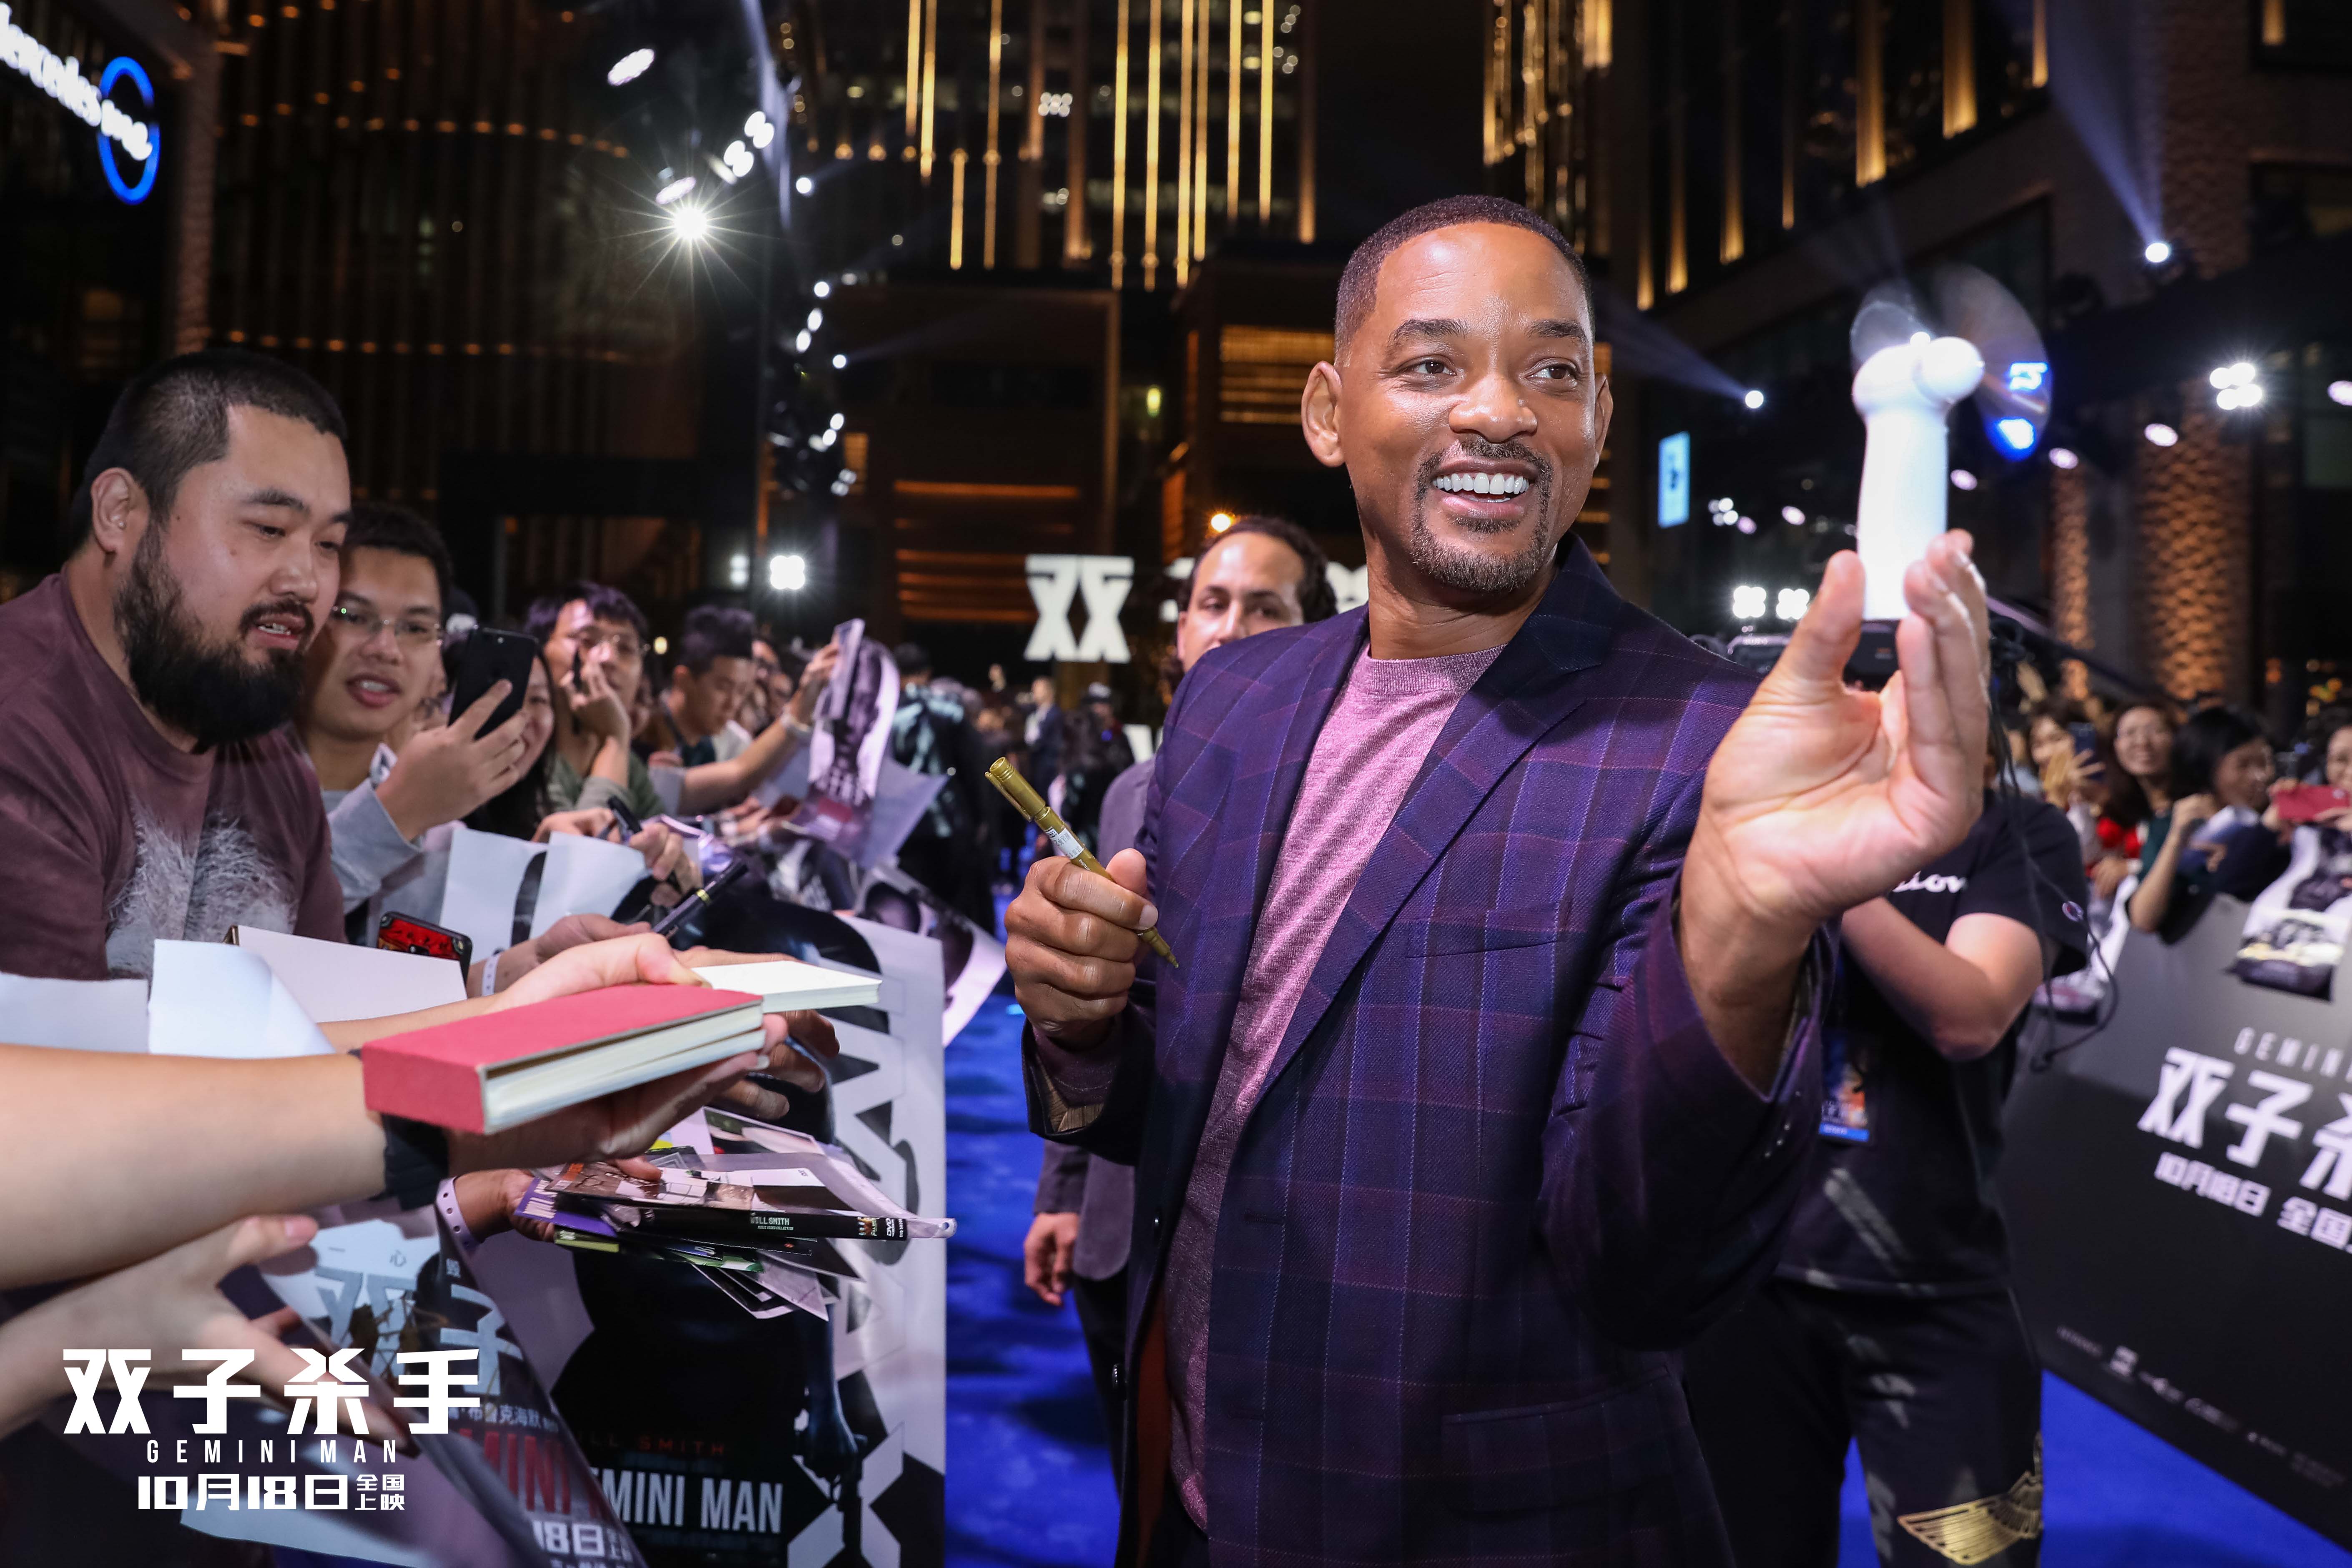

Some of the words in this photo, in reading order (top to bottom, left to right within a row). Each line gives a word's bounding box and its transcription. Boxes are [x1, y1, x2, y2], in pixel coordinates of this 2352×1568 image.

[768, 1217, 790, 1225] SMITH
[2277, 1196, 2352, 1254] 全国
[589, 1467, 686, 1528] MINI
[700, 1477, 783, 1534] MAN
